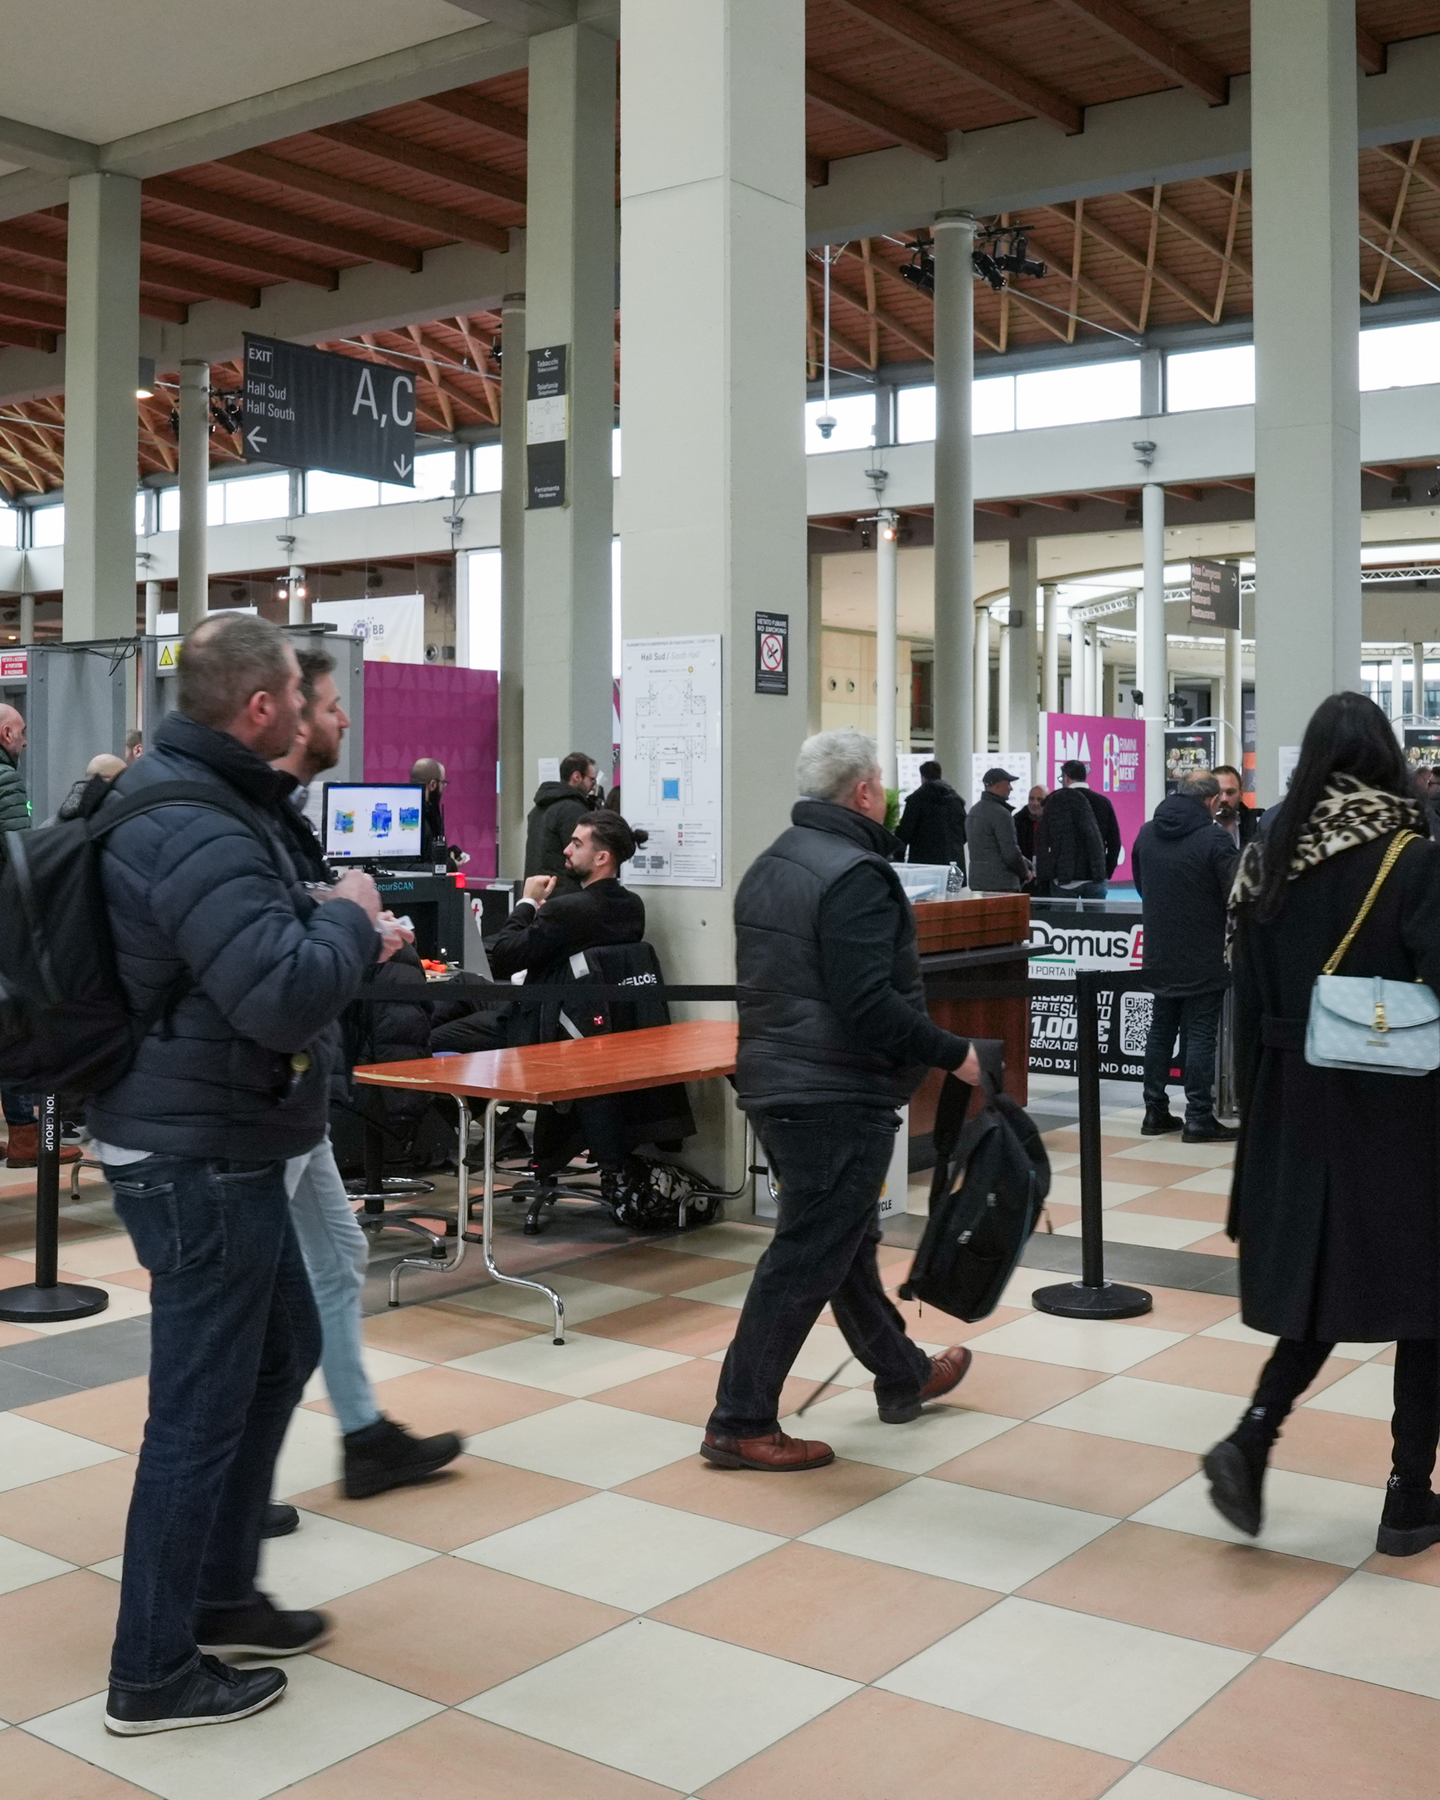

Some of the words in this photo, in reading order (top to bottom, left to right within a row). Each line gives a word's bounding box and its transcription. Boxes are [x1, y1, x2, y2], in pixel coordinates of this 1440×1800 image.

[250, 348, 272, 362] EXIT
[247, 380, 265, 396] Hall
[268, 385, 286, 400] Sud
[352, 368, 413, 428] A,C
[247, 399, 265, 415] Hall
[268, 404, 295, 420] South
[373, 625, 384, 634] BB
[765, 626, 787, 634] SMOKING
[1120, 752, 1139, 766] AMUSE
[1120, 767, 1135, 780] MENT
[1036, 966, 1066, 976] PORTA
[1031, 1002, 1047, 1011] PER
[1049, 1003, 1059, 1012] TE
[1030, 1039, 1060, 1050] SENZA
[1029, 1057, 1052, 1068] PAD
[1056, 1059, 1070, 1069] D3
[46, 1117, 54, 1151] GROUP
